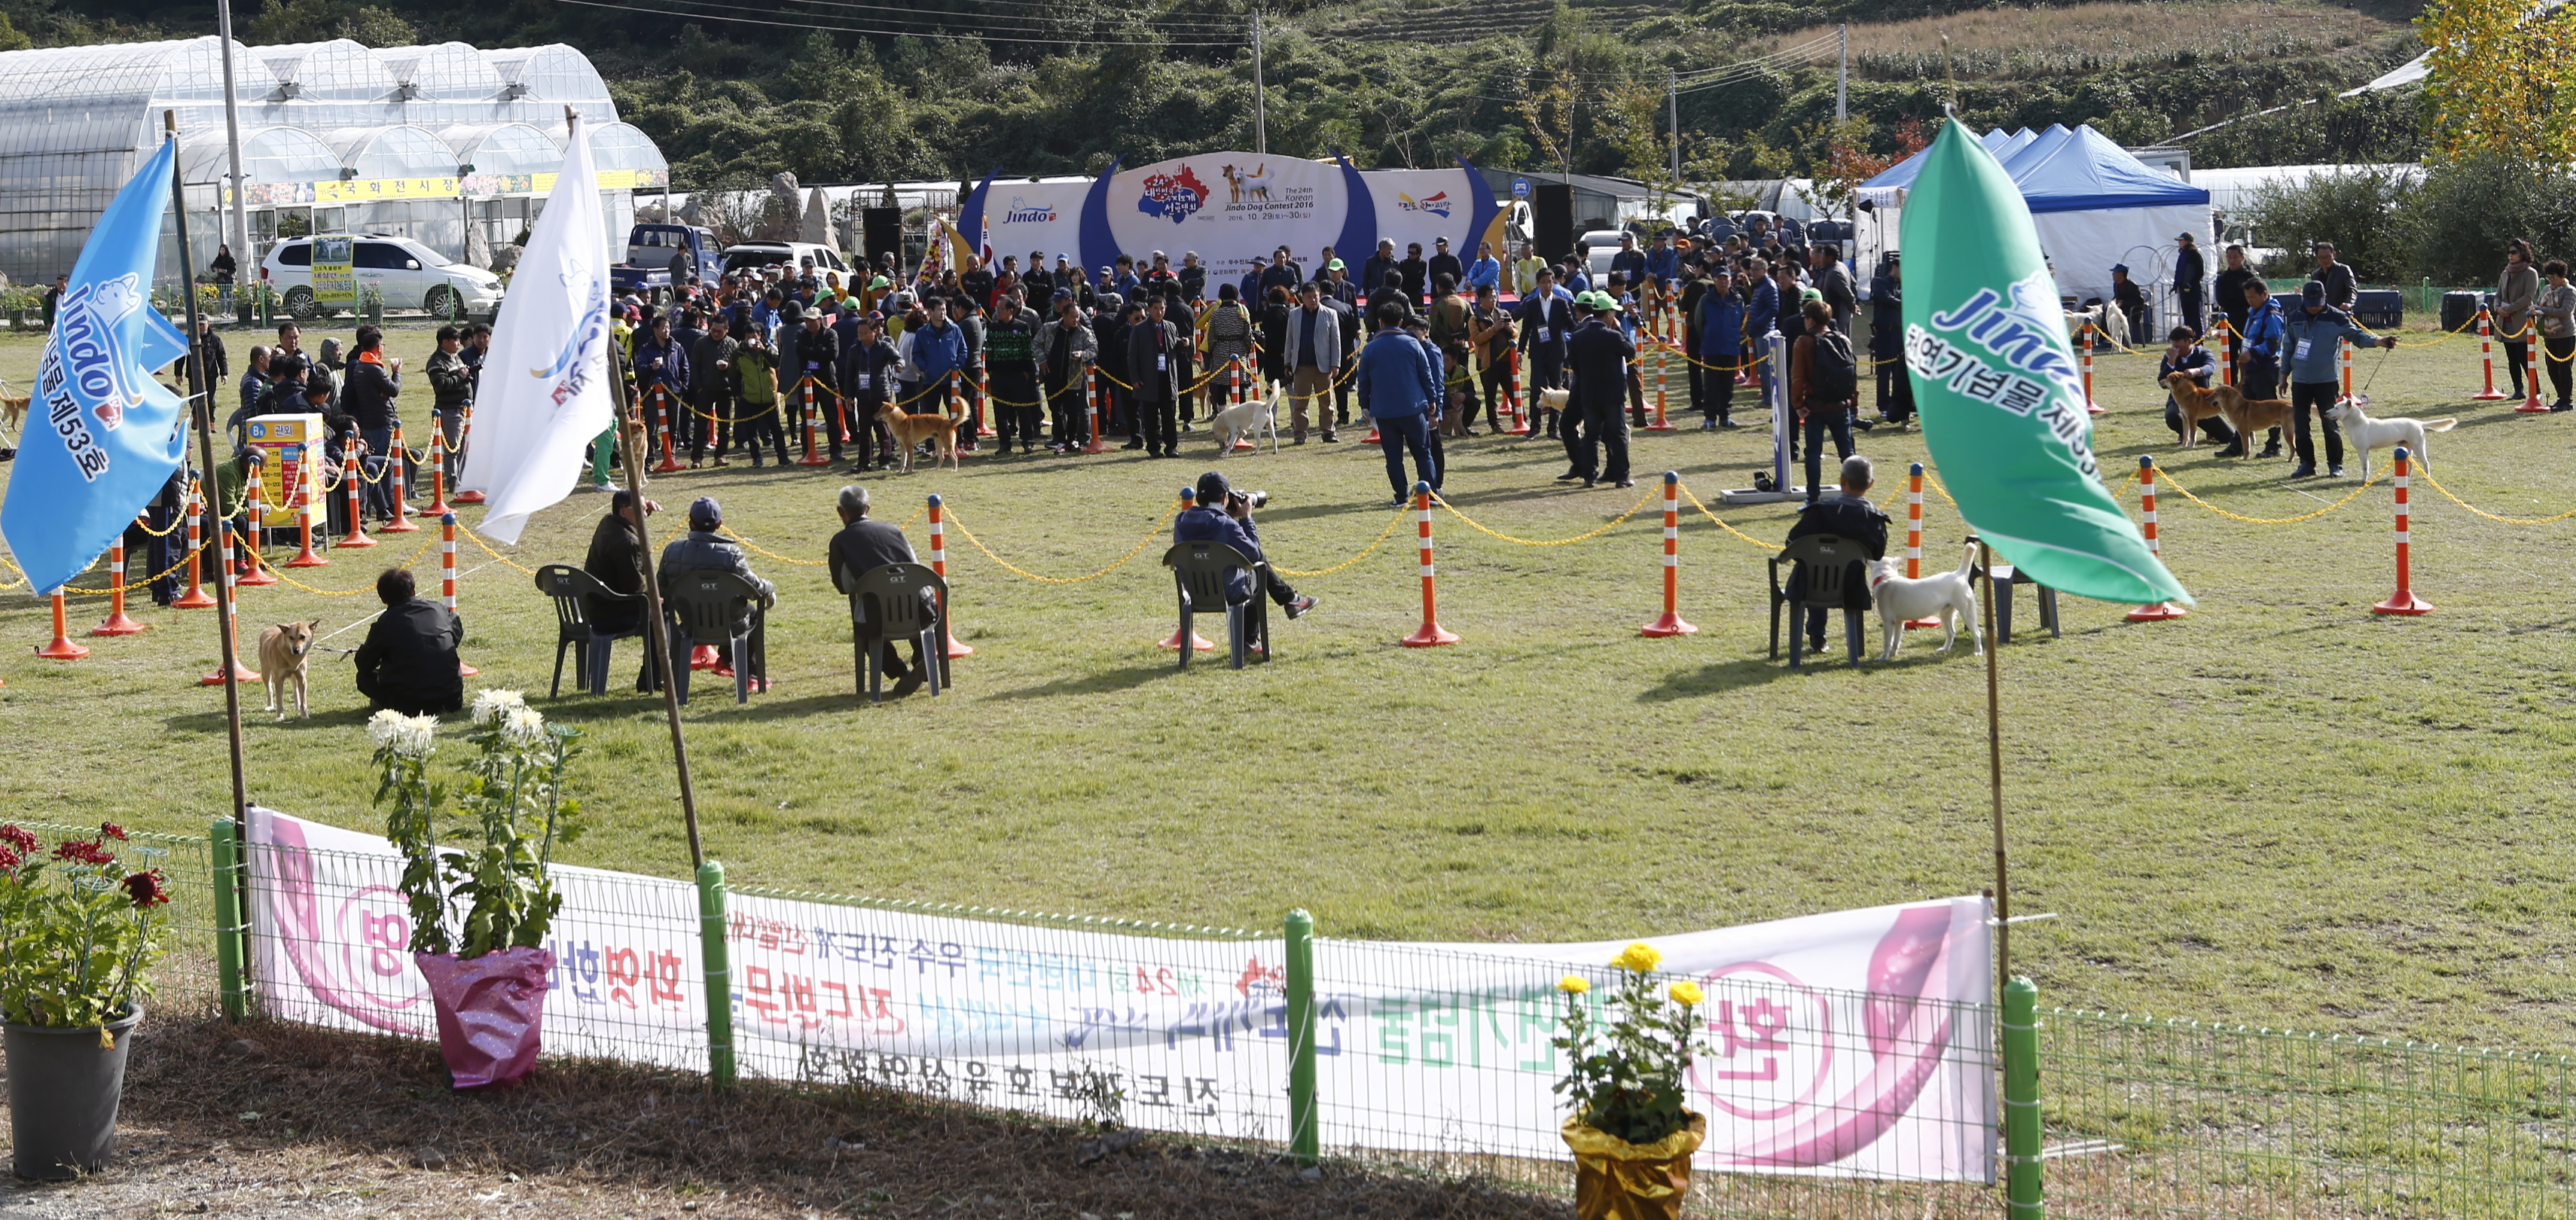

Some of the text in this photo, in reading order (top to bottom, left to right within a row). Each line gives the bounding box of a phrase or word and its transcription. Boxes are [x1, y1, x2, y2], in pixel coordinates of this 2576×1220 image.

[1145, 188, 1174, 197] 대한민국
[1164, 203, 1196, 215] 선발대회
[1225, 203, 1246, 212] Jindo
[1247, 203, 1263, 212] Dog
[1265, 202, 1293, 210] Contest
[1003, 210, 1047, 224] Jindo
[60, 283, 114, 398] Jindo
[1906, 326, 2044, 413] 천연기념물
[50, 390, 107, 480] 제53호
[275, 424, 293, 437] 관외
